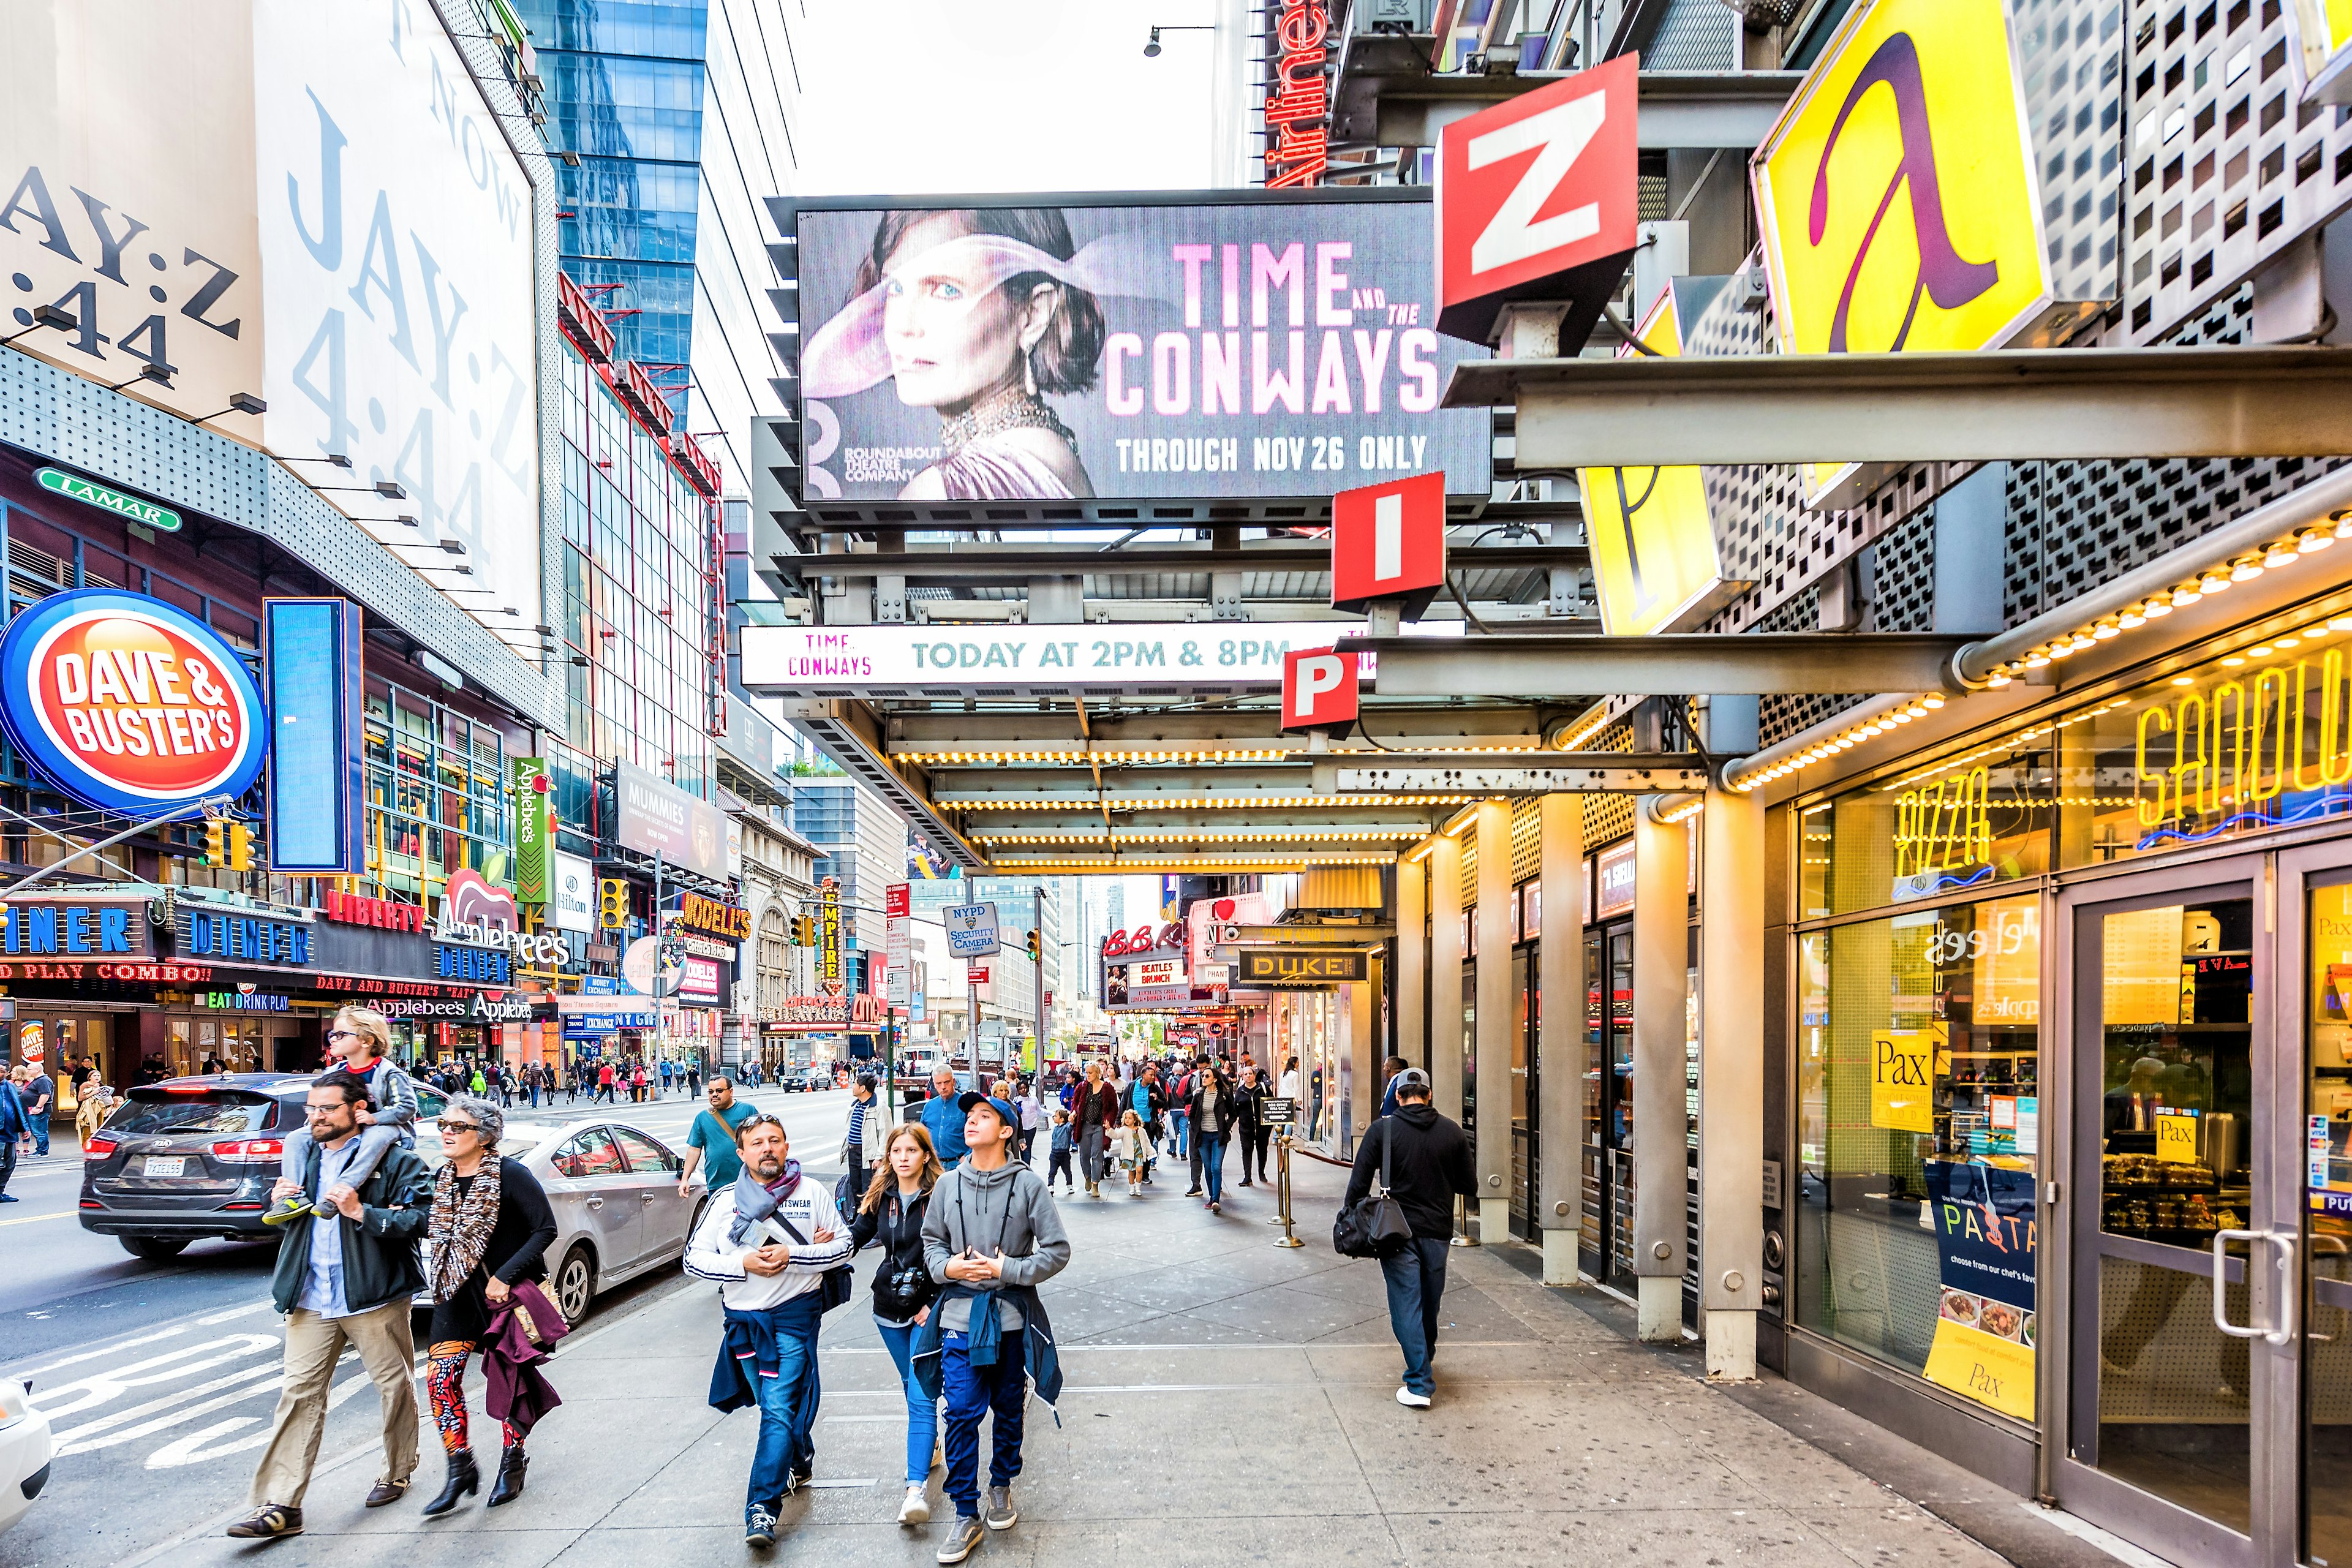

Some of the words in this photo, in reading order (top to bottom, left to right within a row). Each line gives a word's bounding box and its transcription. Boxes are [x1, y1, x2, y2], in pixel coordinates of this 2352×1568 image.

[429, 47, 521, 242] NOW
[1468, 88, 1607, 276] Z
[287, 83, 529, 497] JAY:Z
[1172, 243, 1353, 329] TIME
[1352, 288, 1385, 310] AND
[1387, 303, 1420, 326] THE
[1105, 328, 1438, 417] CONWAYS
[293, 307, 491, 590] 4:44
[845, 447, 942, 459] ROUNDABOUT
[1115, 437, 1238, 474] THROUGH
[1253, 435, 1306, 473] NOV
[1310, 435, 1345, 472] 26
[1359, 434, 1428, 472] ONLY
[844, 458, 901, 470] THEATRE
[845, 469, 916, 482] COMPANY
[61, 478, 162, 524] LAMAR
[805, 634, 849, 654] TIME
[911, 642, 1027, 669] TODAY
[1038, 641, 1079, 668] AT
[1091, 641, 1165, 668] 2PM
[1177, 640, 1205, 666] &
[1217, 639, 1289, 667] 8PM
[789, 656, 872, 676] CONWAYS
[55, 649, 190, 705] DAVE
[184, 657, 228, 707] &
[1295, 654, 1344, 717] P
[63, 707, 235, 756] BUSTER'S
[516, 761, 540, 843] Applebee's
[628, 782, 684, 826] MUMMIES
[628, 807, 644, 818] UNWRAP
[651, 816, 665, 827] SECRETS
[669, 824, 684, 836] MUMMIES
[1895, 766, 1991, 880] PIZZA
[647, 827, 657, 839] NOW
[657, 832, 668, 843] OPEN
[327, 889, 425, 934] LIBERTY
[557, 892, 586, 914] Hilton
[953, 907, 986, 919] NYPD
[683, 892, 752, 940] MODELL'S
[888, 921, 892, 931] 3
[2319, 917, 2351, 936] Pax
[190, 912, 309, 963] DINER
[436, 894, 570, 965] Applebee's
[684, 932, 709, 943] SPORTING
[710, 937, 728, 946] GOODS
[824, 894, 838, 977] EMPIRE
[951, 928, 994, 940] SECURITY
[1155, 922, 1183, 949] K
[1284, 928, 1293, 941] W
[1295, 927, 1321, 941] 42ND
[954, 937, 994, 949] CAMERA
[23, 964, 83, 978] PLAY
[97, 964, 212, 981] COMBO!!
[439, 946, 509, 982] DINER
[629, 965, 676, 978] Hiln
[1141, 962, 1173, 974] BEATLES
[1254, 957, 1343, 975] DUKE
[316, 976, 352, 991] DAVE
[357, 980, 384, 993] AND
[388, 982, 439, 997] BUSTER'S
[447, 986, 475, 999] "EAT"
[888, 973, 893, 984] 5
[1142, 973, 1170, 984] BRUNCH
[208, 992, 232, 1009] EAT
[235, 993, 268, 1010] DRINK
[270, 995, 288, 1011] PLAY
[587, 987, 613, 995] EXCHANGE
[784, 995, 826, 1007] amc
[826, 995, 846, 1007] 25
[366, 999, 466, 1019] Applebee's
[586, 1017, 614, 1029] EXCHANGE
[21, 1030, 43, 1049] DAVE
[1875, 1041, 1928, 1086] Pax
[1875, 1092, 1928, 1106] WHOLESOME
[1876, 1109, 1928, 1120] FOODS
[2160, 1120, 2193, 1143] Pax
[1943, 1202, 2037, 1254] PASTA
[1951, 1255, 1972, 1268] choose
[1972, 1259, 1988, 1272] from
[1988, 1265, 2000, 1274] our
[2000, 1267, 2021, 1280] chef's
[1954, 1336, 1975, 1348] comfort
[1975, 1342, 1989, 1354] food
[1996, 1350, 2019, 1364] comfort
[1968, 1362, 2004, 1398] Pax
